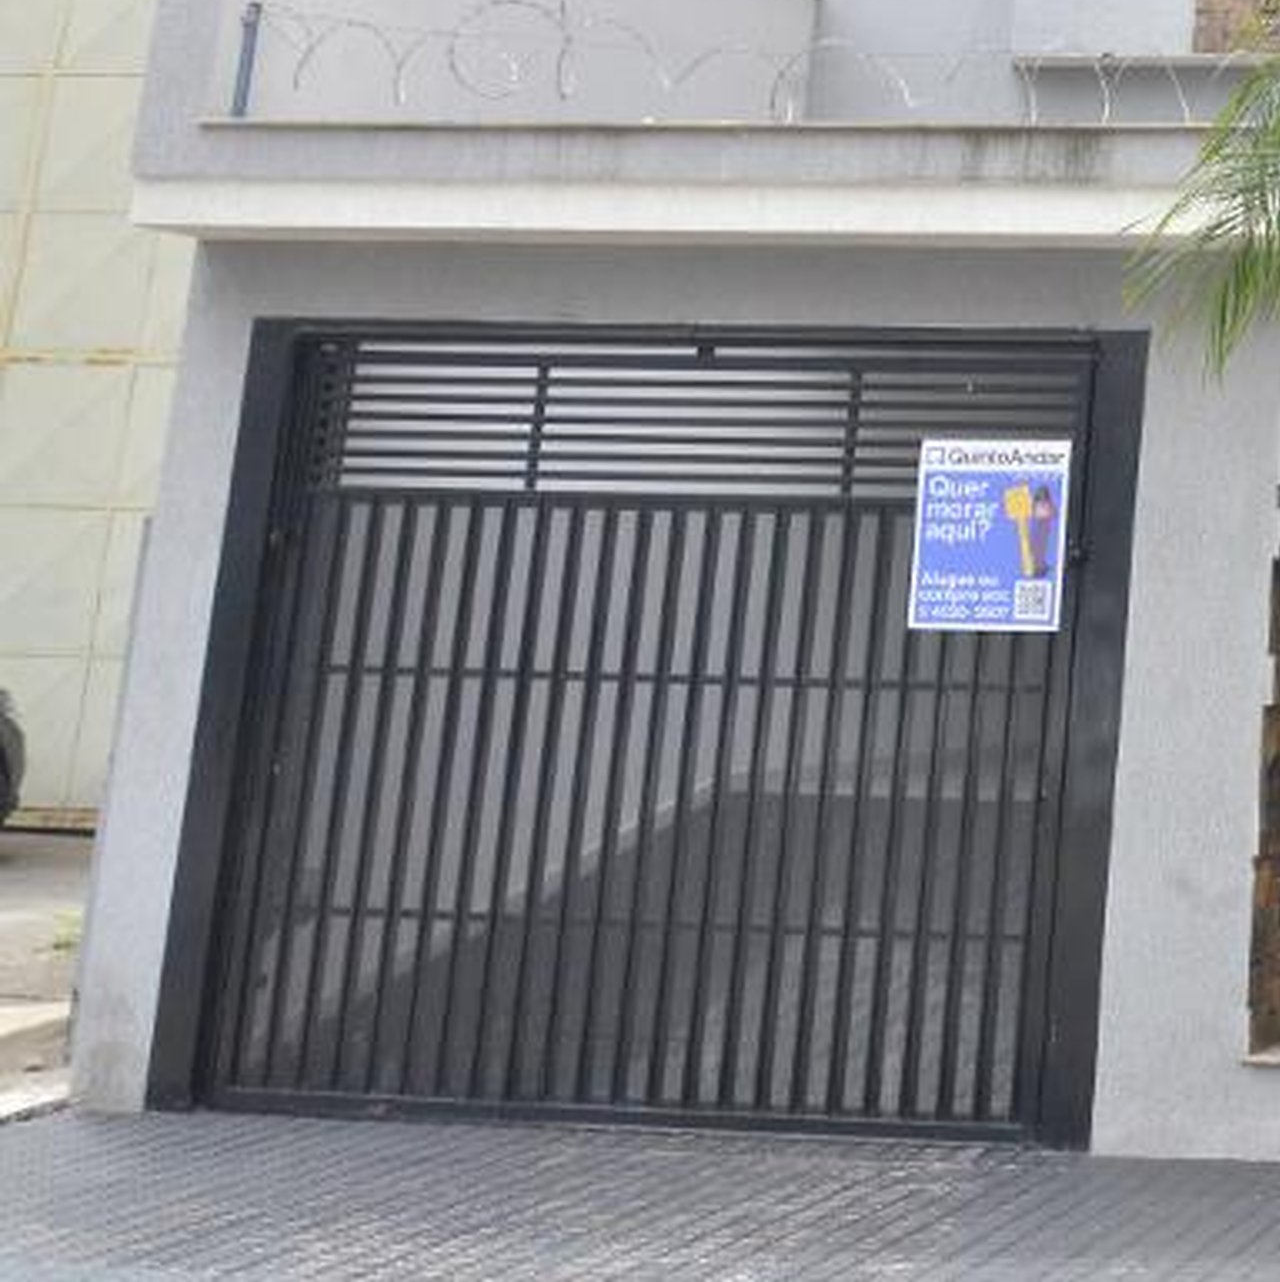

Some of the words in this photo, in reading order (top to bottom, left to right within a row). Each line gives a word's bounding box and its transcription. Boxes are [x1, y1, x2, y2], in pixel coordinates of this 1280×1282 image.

[948, 448, 1065, 466] QuintoAndar
[928, 474, 989, 499] Quer
[926, 500, 998, 518] morar
[925, 519, 991, 544] aqui?
